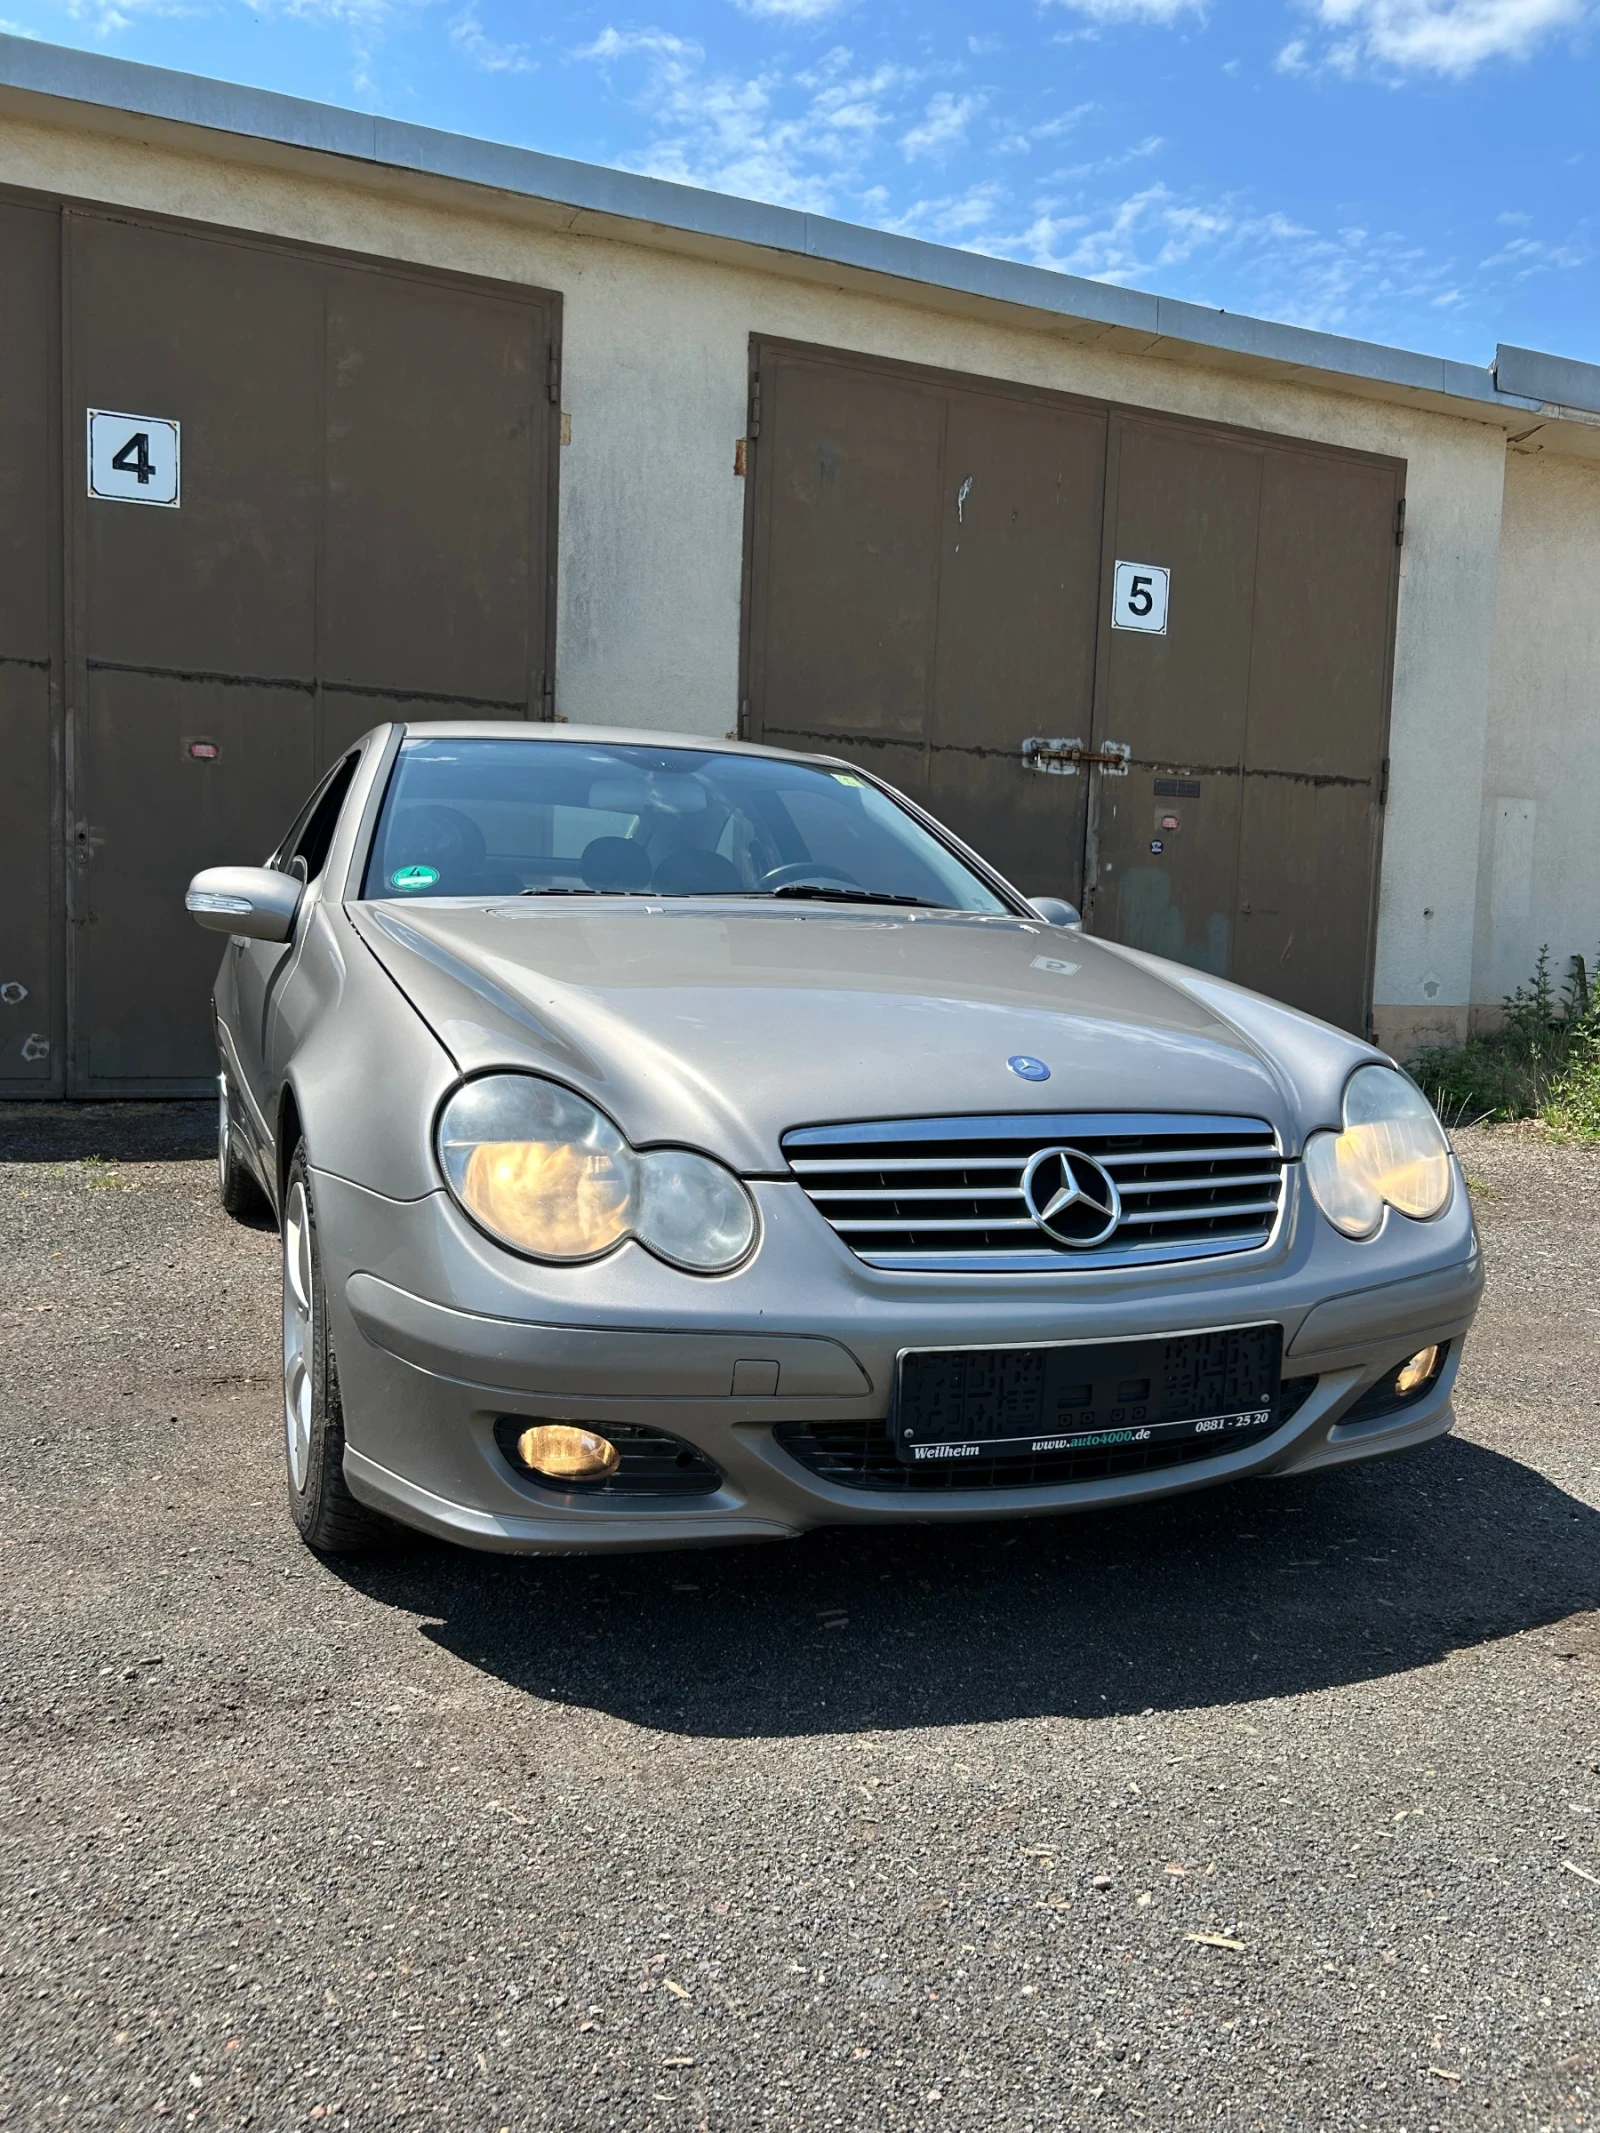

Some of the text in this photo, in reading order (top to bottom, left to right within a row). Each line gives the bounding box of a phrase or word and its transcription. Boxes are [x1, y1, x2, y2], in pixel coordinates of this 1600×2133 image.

[112, 432, 156, 485] 4
[1128, 575, 1153, 617] 5
[409, 866, 421, 877] 4
[1195, 1419, 1225, 1433] 0881
[1235, 1415, 1251, 1427] 25
[1253, 1412, 1269, 1424] 20
[1031, 1428, 1151, 1451] www.auto4000.de
[914, 1444, 980, 1460] Weilheim
